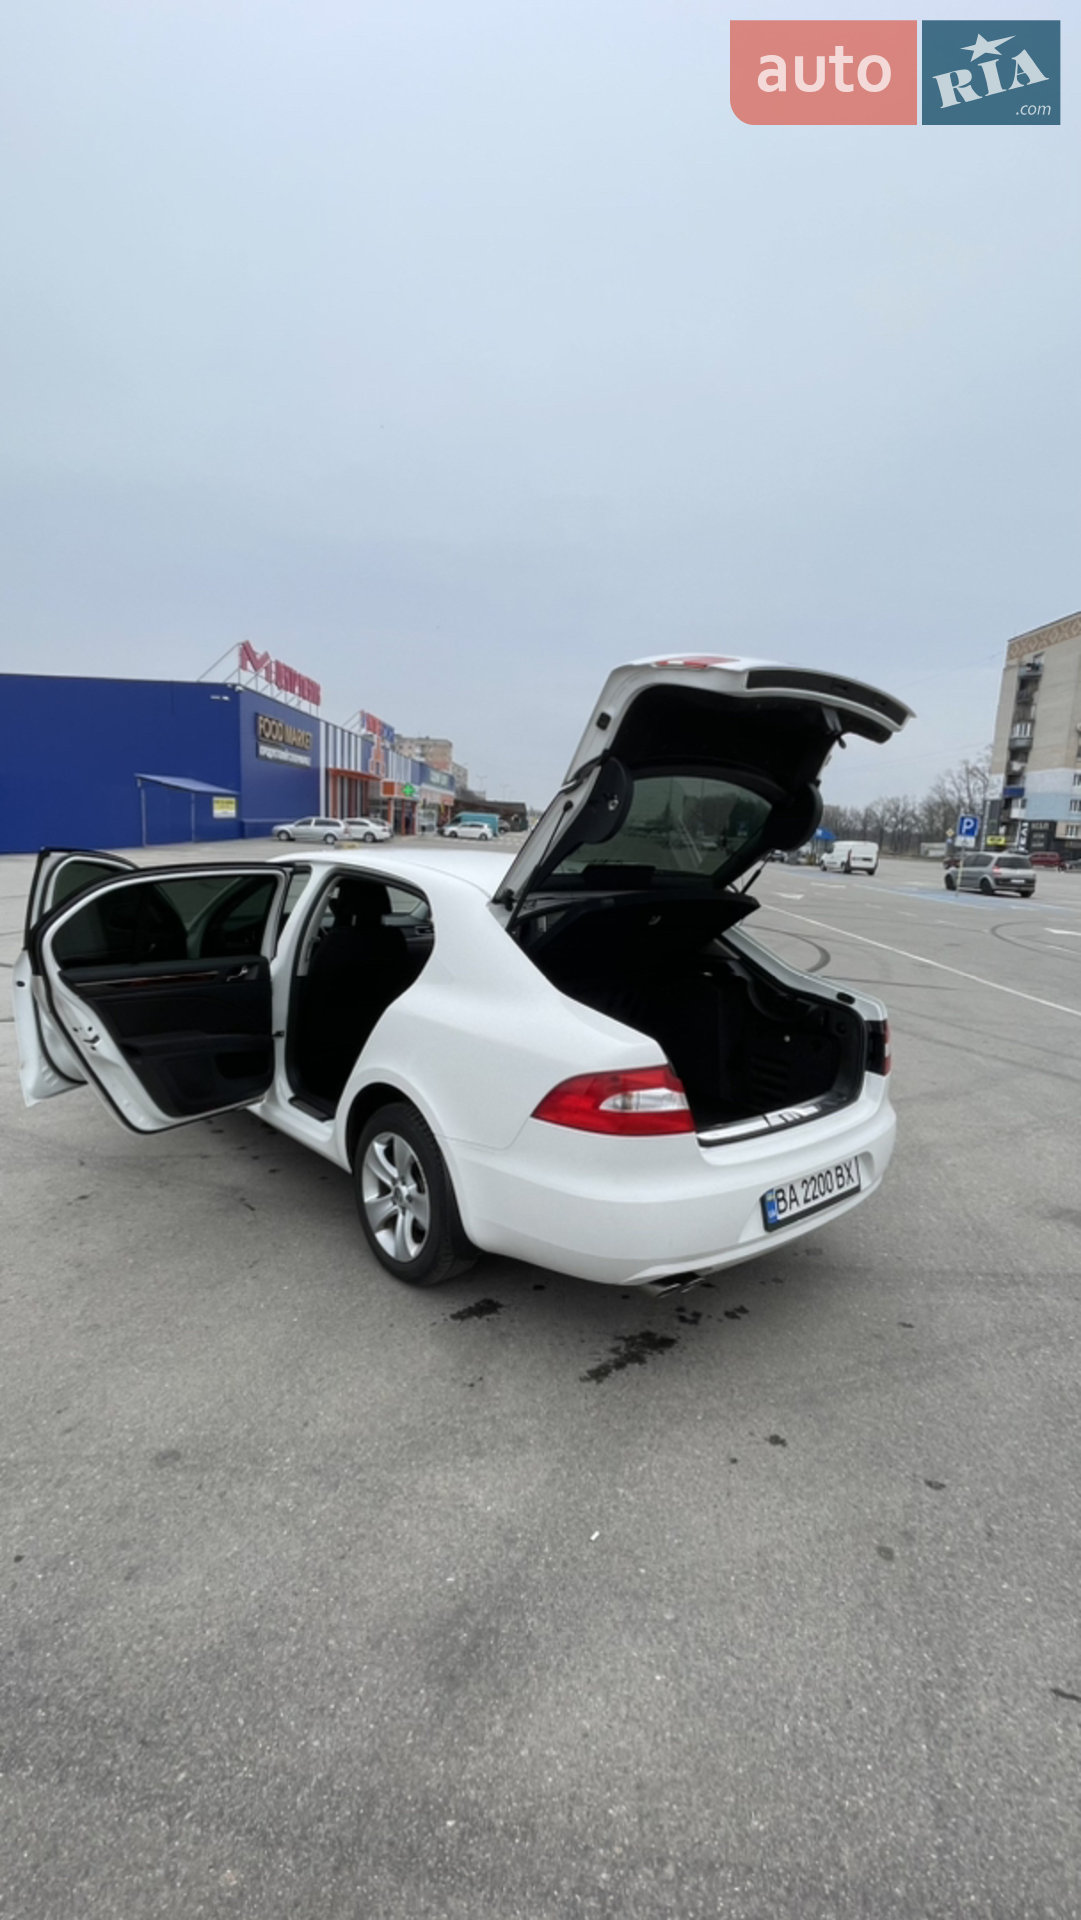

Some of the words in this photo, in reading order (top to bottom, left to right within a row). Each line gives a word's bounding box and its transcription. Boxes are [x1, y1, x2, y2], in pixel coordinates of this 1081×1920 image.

[259, 716, 283, 742] FOOD
[962, 818, 974, 834] P
[774, 1184, 799, 1215] BA
[801, 1169, 834, 1204] 2200
[835, 1160, 855, 1189] BX
